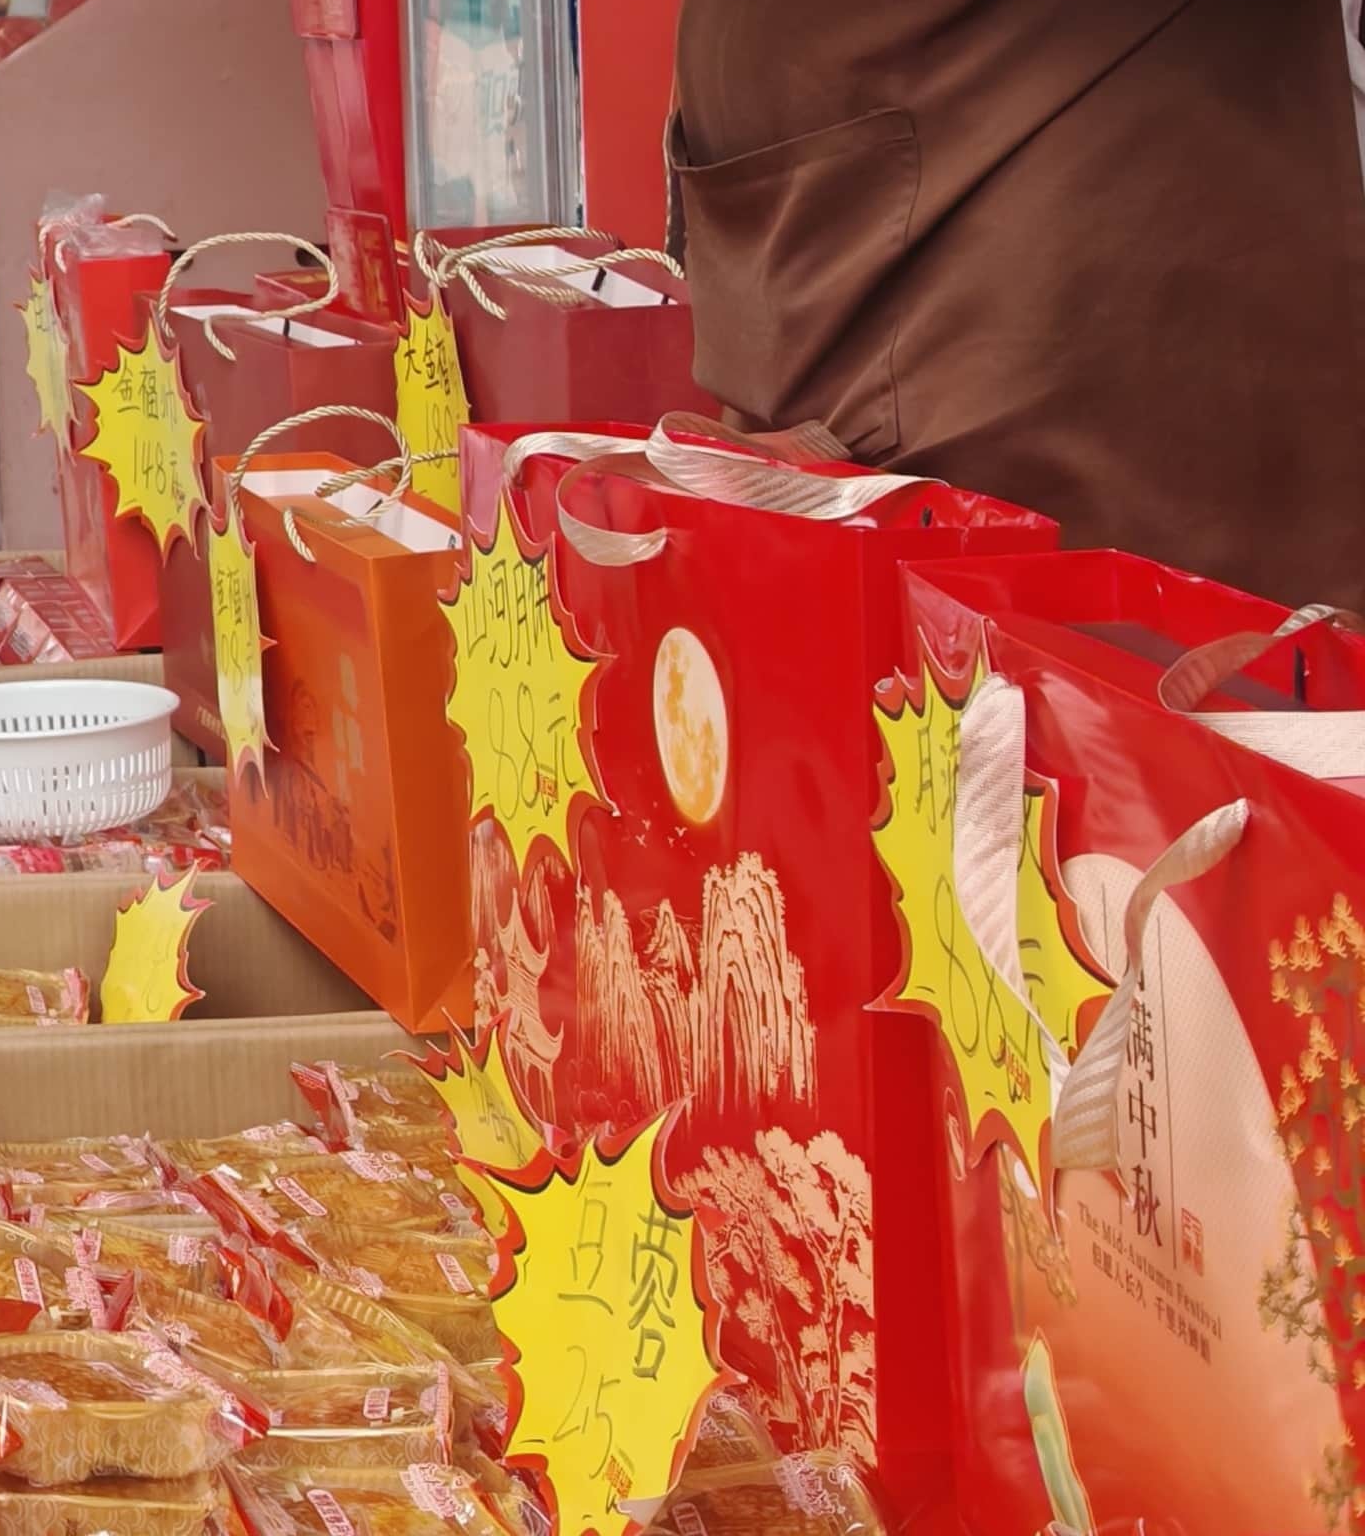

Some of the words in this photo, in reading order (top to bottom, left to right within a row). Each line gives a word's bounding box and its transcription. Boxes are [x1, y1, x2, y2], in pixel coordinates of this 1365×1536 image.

[1126, 968, 1163, 1247] 满中秋
[1176, 1283, 1223, 1341] Festival
